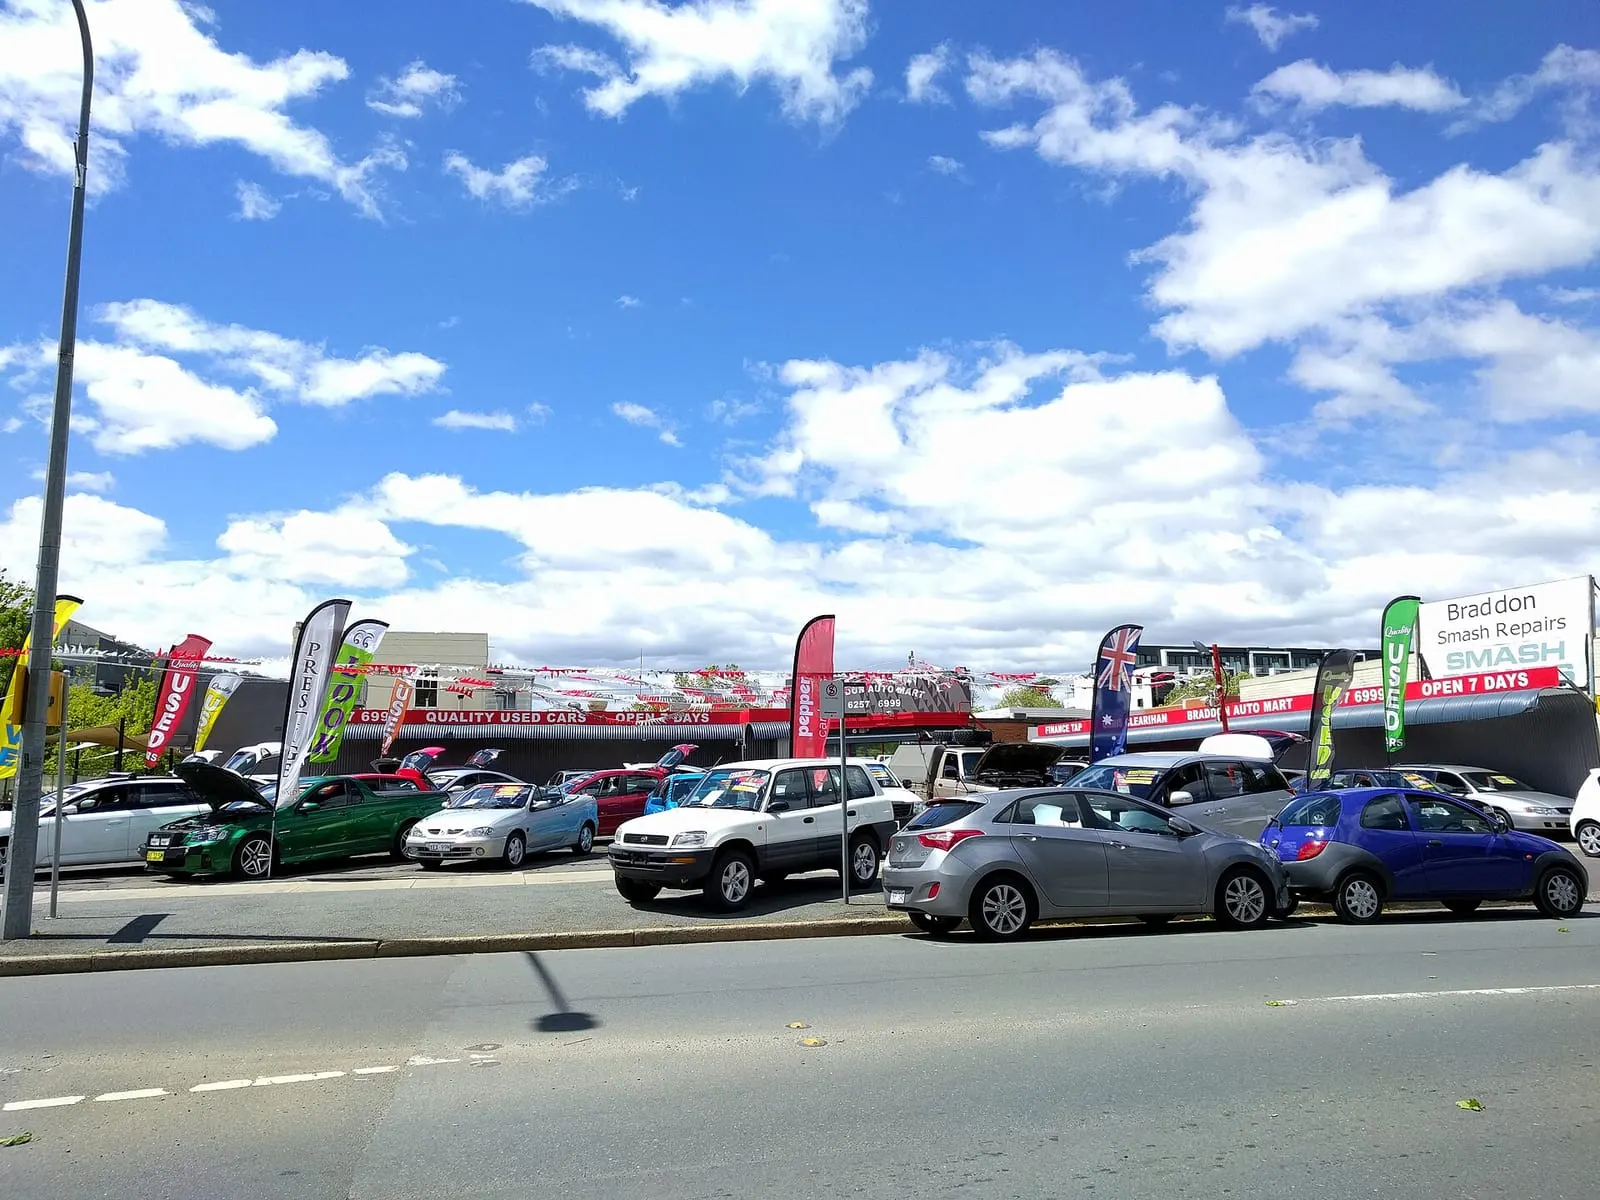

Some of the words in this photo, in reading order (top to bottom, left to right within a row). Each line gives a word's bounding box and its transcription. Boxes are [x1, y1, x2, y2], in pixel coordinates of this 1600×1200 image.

[1447, 594, 1536, 621] Braddon
[1384, 625, 1412, 638] Quality
[1438, 624, 1490, 645] Smash
[1496, 616, 1567, 638] Repairs
[1446, 640, 1566, 670] SMASH
[867, 684, 894, 694] AUTO
[896, 687, 926, 699] MART
[1385, 642, 1404, 732] USED
[1421, 675, 1463, 697] OPEN
[1467, 677, 1480, 692] 7
[1484, 671, 1530, 691] DAYS
[148, 672, 191, 748] USED
[314, 655, 360, 756] LOOK
[426, 711, 494, 723] QUALITY
[500, 712, 541, 723] USED
[546, 711, 587, 723] CARS
[798, 676, 814, 737] pepper
[847, 700, 870, 709] 6257
[878, 699, 902, 708] 6999
[1233, 702, 1260, 716] AUTO
[1263, 697, 1294, 712] MART
[615, 712, 655, 723] OPEN
[674, 712, 710, 723] DAYS
[1045, 725, 1070, 735] FINANCE
[1071, 722, 1083, 732] TAP
[1316, 684, 1342, 765] USED
